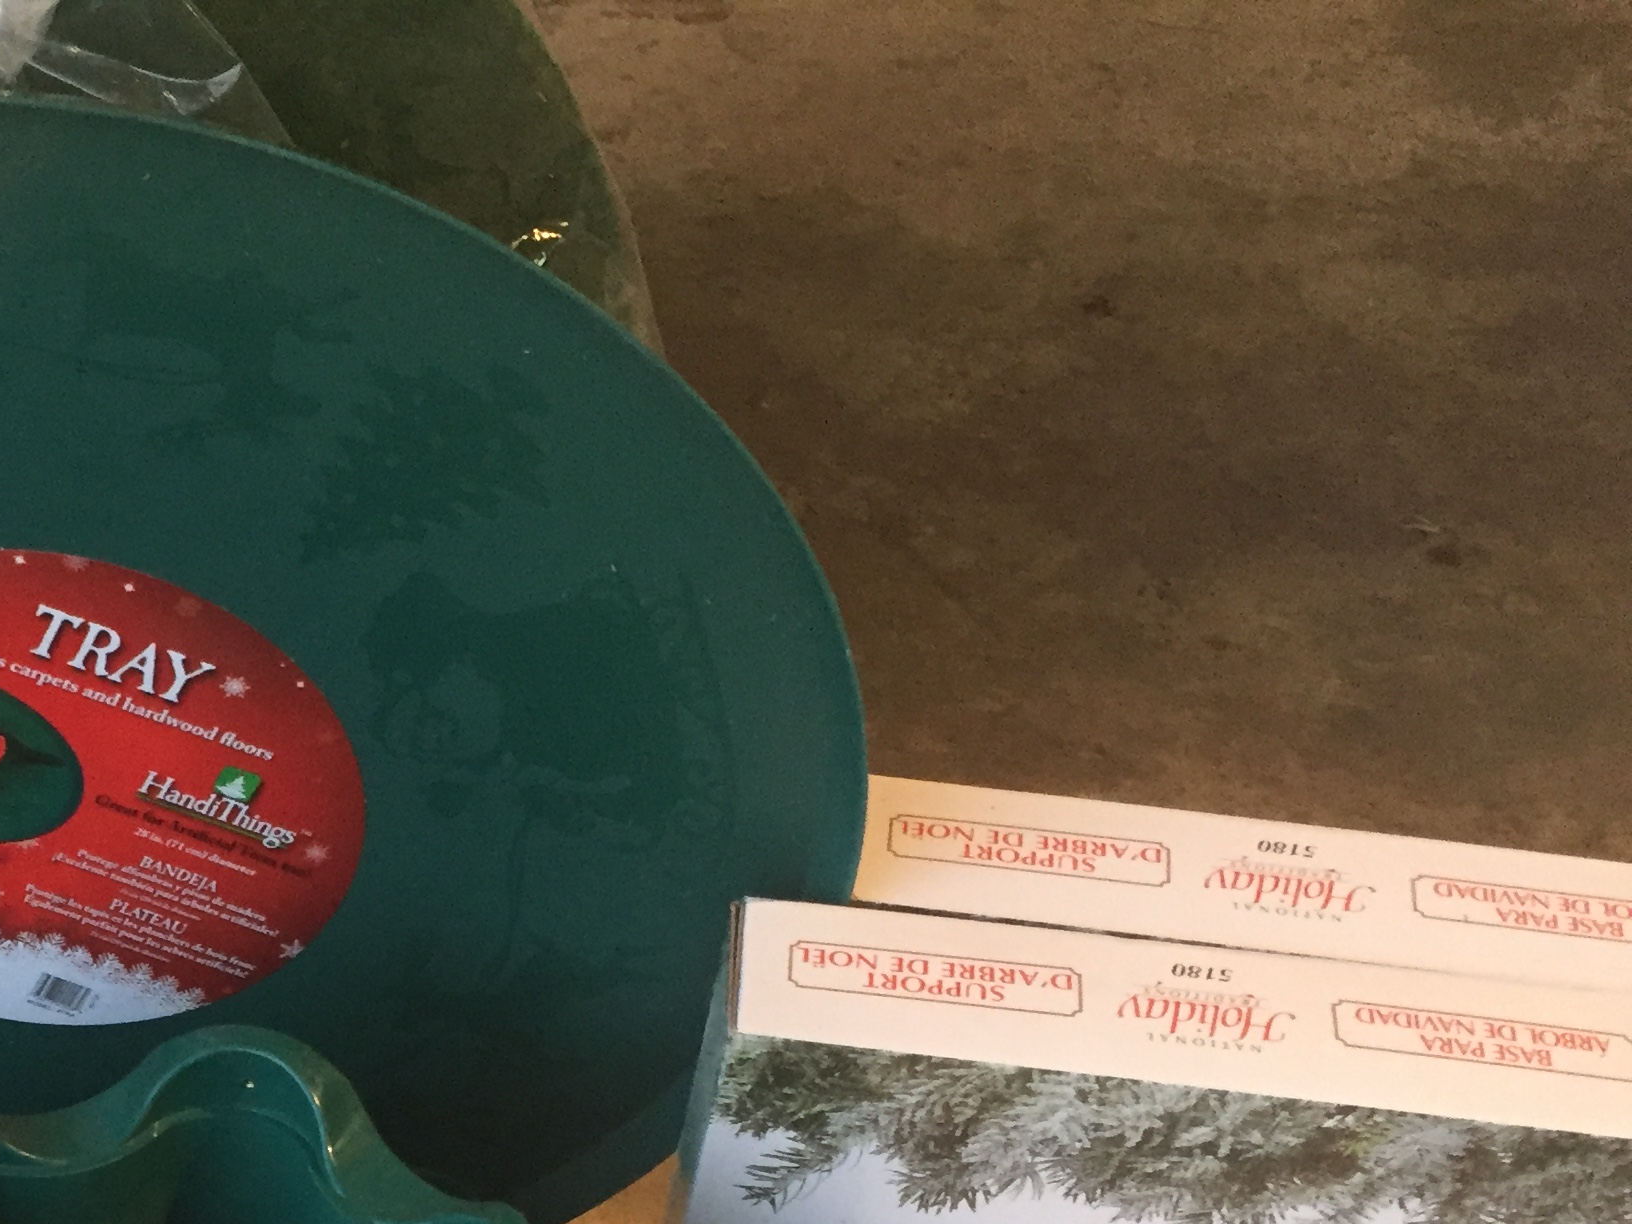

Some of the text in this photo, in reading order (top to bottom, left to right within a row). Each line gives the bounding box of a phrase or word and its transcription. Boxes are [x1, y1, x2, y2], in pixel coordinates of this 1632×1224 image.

[30, 604, 216, 703] TRAY
[9, 662, 79, 693] carpets
[82, 686, 121, 707] and
[123, 698, 219, 741] hardwood
[219, 731, 274, 760] floors
[138, 771, 297, 848] HandiThings
[990, 829, 1024, 848] DE
[1037, 835, 1162, 863] D'ARBRE
[1257, 840, 1317, 858] 5180
[140, 856, 217, 892] BANDEJA
[960, 844, 1096, 873] SUPPORT
[1204, 868, 1376, 911] Holiday
[1433, 881, 1550, 909] NAVIDAD
[1558, 896, 1590, 915] DE
[110, 899, 187, 935] PLATEAU
[1496, 907, 1624, 938] BASE PARA
[799, 947, 1073, 990] D'ARBRE DE NOËL
[1171, 963, 1234, 982] 5180
[863, 972, 1005, 1002] SUPPORT
[1116, 994, 1296, 1041] Holiday
[1355, 1006, 1610, 1058] ÁRBOL DE NAVIDAD
[1146, 1032, 1262, 1053] NATIONAL
[1419, 1034, 1553, 1067] BASE PARA
